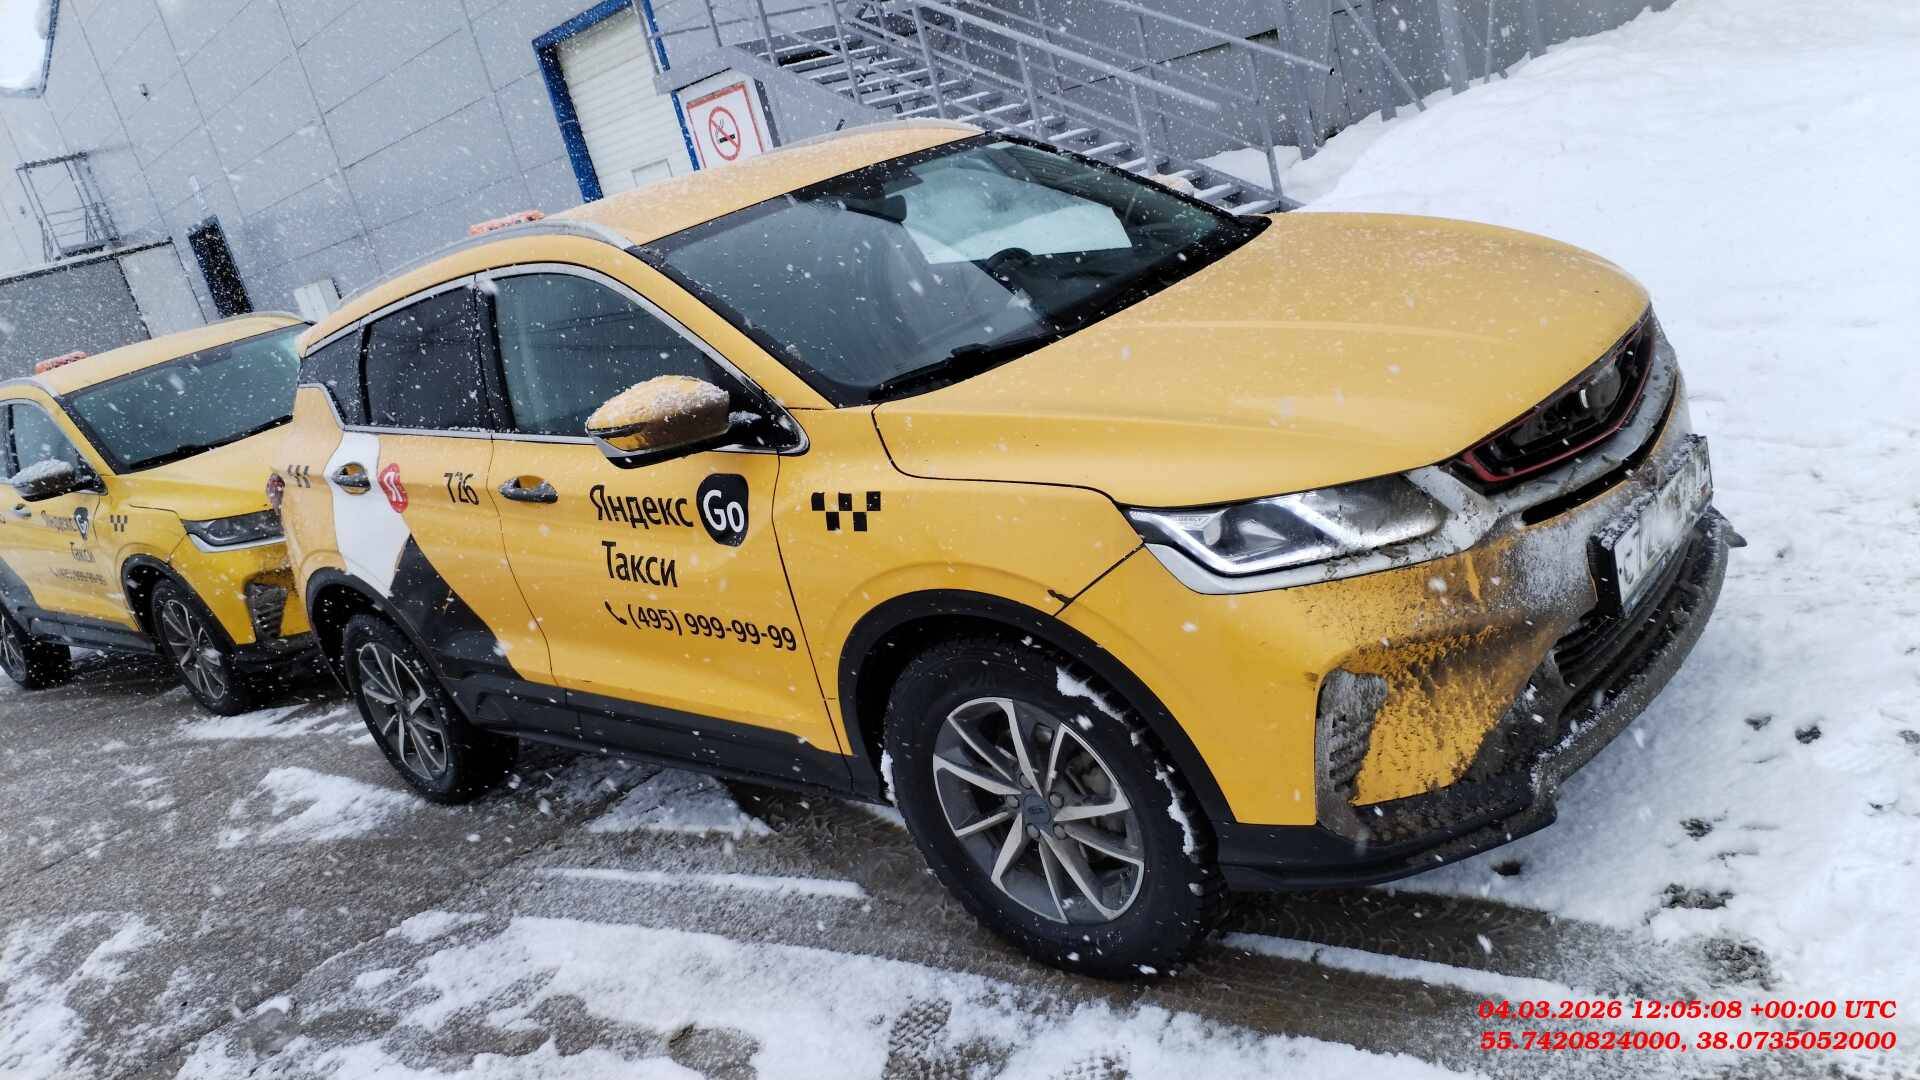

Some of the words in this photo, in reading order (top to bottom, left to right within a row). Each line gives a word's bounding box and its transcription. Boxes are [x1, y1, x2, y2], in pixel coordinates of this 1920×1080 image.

[444, 472, 479, 505] 726
[589, 485, 694, 529] Яндекс
[703, 488, 746, 533] Go
[601, 540, 678, 587] Такси
[628, 604, 682, 635] (495)
[684, 612, 796, 651] 999-99-99
